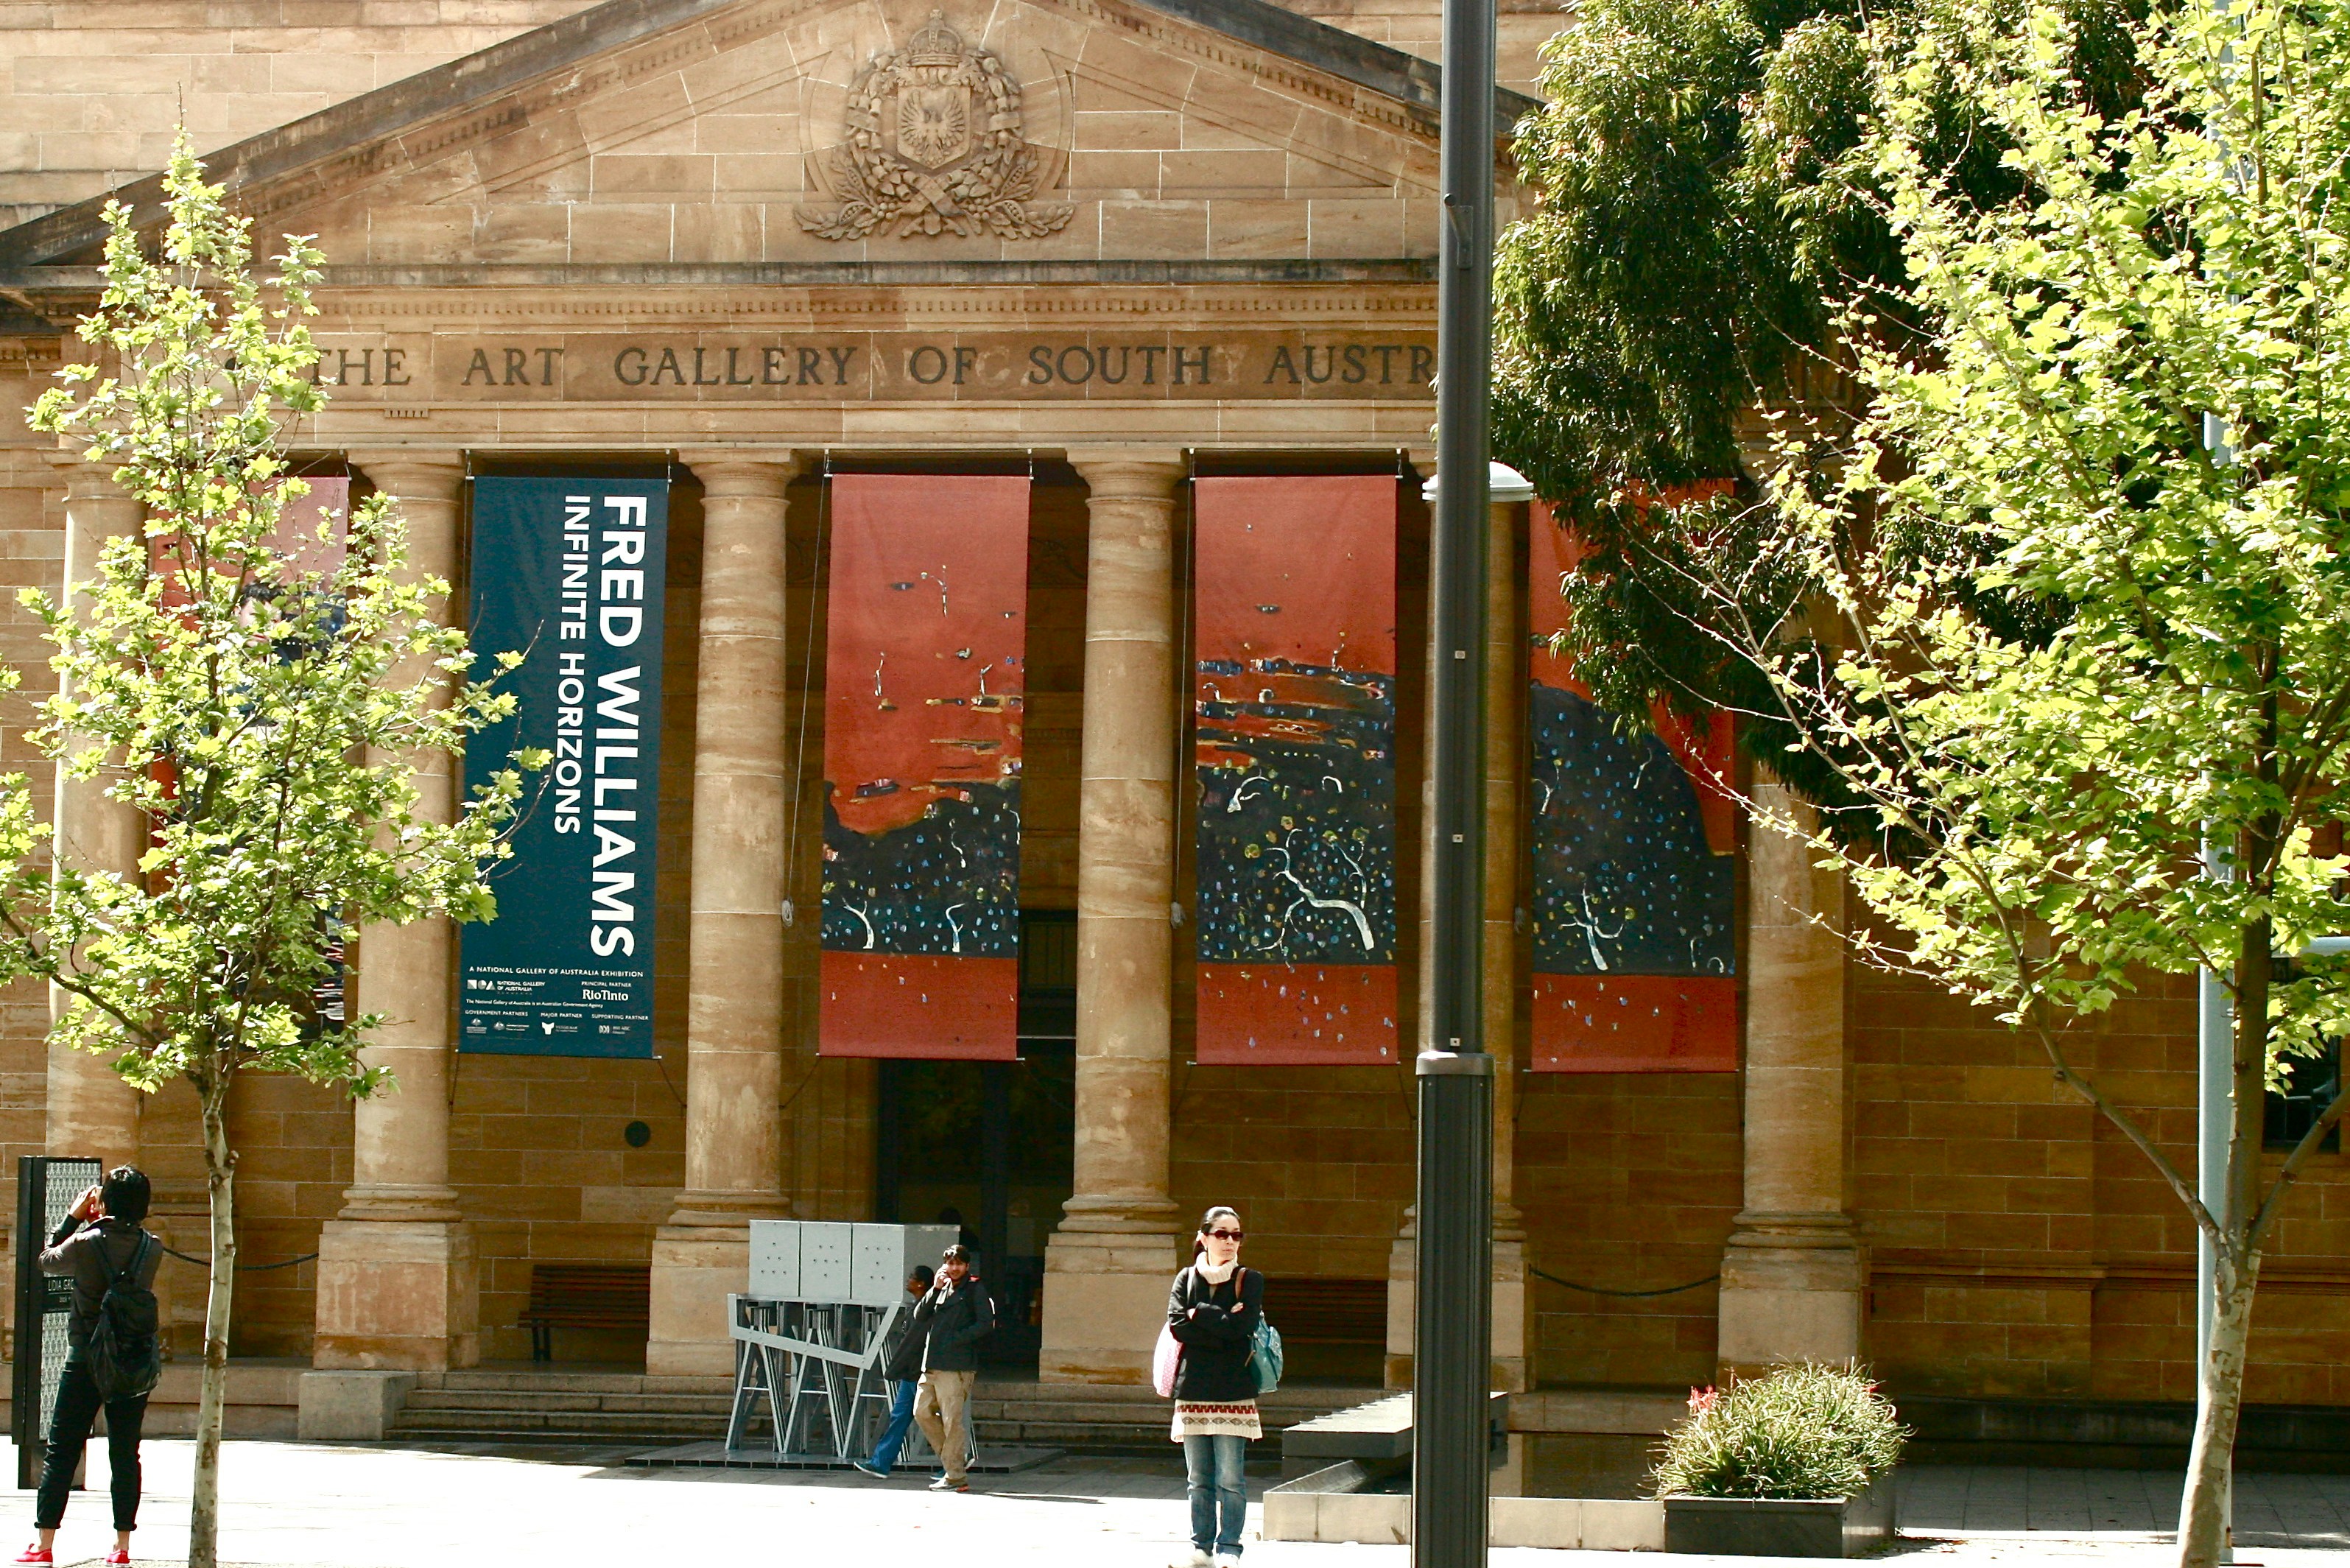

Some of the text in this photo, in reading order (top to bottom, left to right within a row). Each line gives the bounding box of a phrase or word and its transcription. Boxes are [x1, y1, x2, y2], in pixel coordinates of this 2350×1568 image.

[310, 345, 1433, 386] THE ART GALLERY OF SOUTH AUSTR
[554, 496, 591, 834] INFINITE HORIZONS
[590, 496, 647, 957] FRED WILLIAMS
